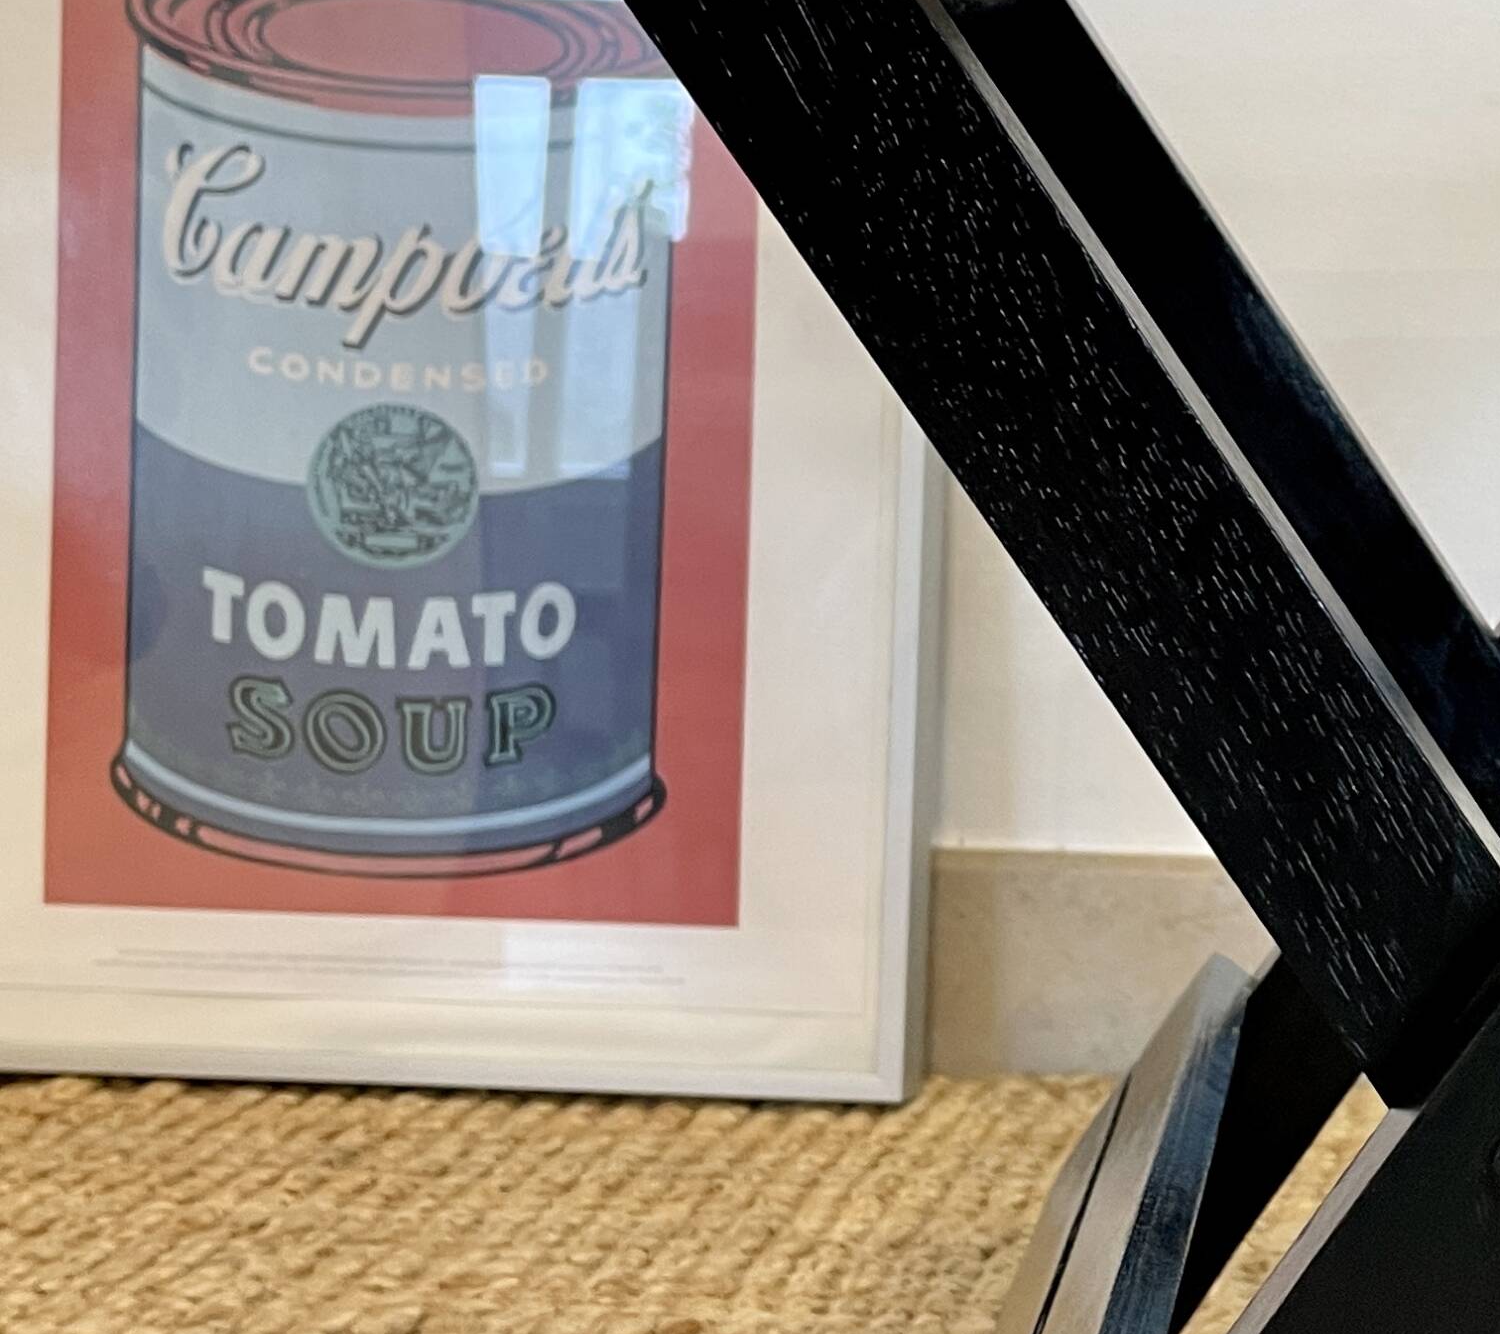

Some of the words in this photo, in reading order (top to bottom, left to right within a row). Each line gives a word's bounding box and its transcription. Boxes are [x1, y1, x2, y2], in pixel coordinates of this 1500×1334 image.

[162, 141, 653, 349] Campbes
[248, 347, 548, 394] CONDENSED
[202, 566, 577, 669] TOMATO
[226, 676, 556, 774] SOUP
